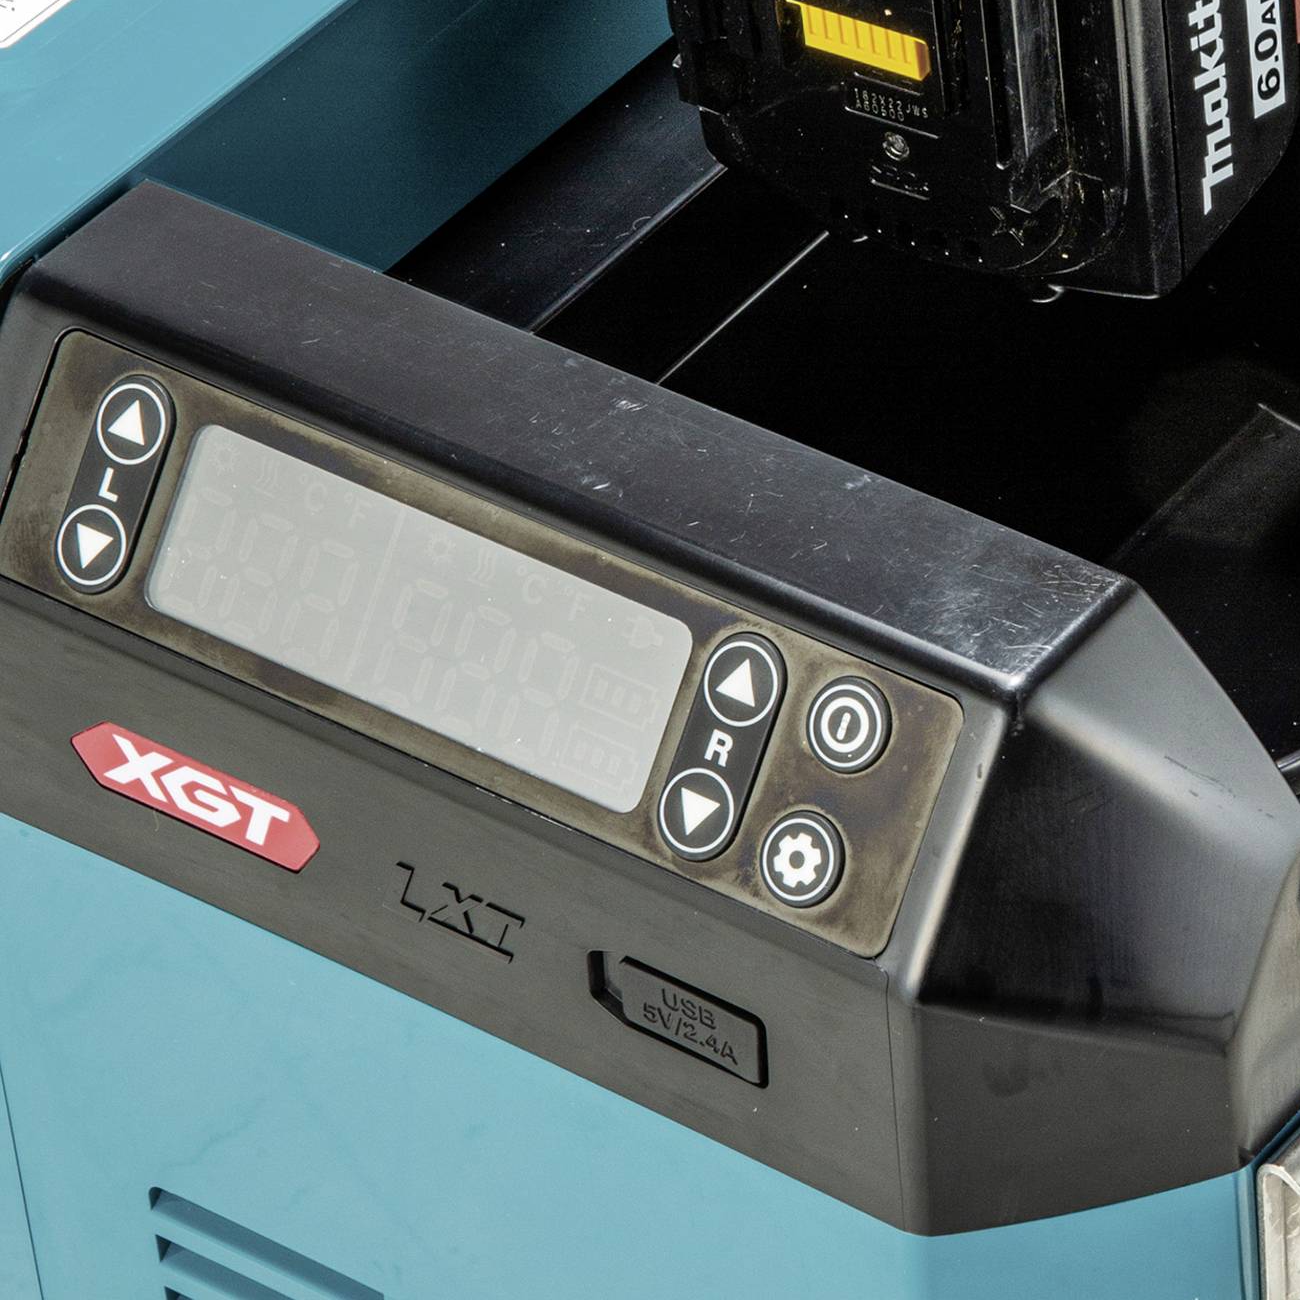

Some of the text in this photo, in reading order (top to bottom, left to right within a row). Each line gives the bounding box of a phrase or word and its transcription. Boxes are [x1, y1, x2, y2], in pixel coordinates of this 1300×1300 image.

[98, 467, 119, 502] L
[704, 728, 734, 768] R
[102, 733, 291, 846] XGT
[383, 860, 526, 964] LXT
[642, 1001, 739, 1066] 5V/2.4A
[661, 987, 717, 1030] USB
